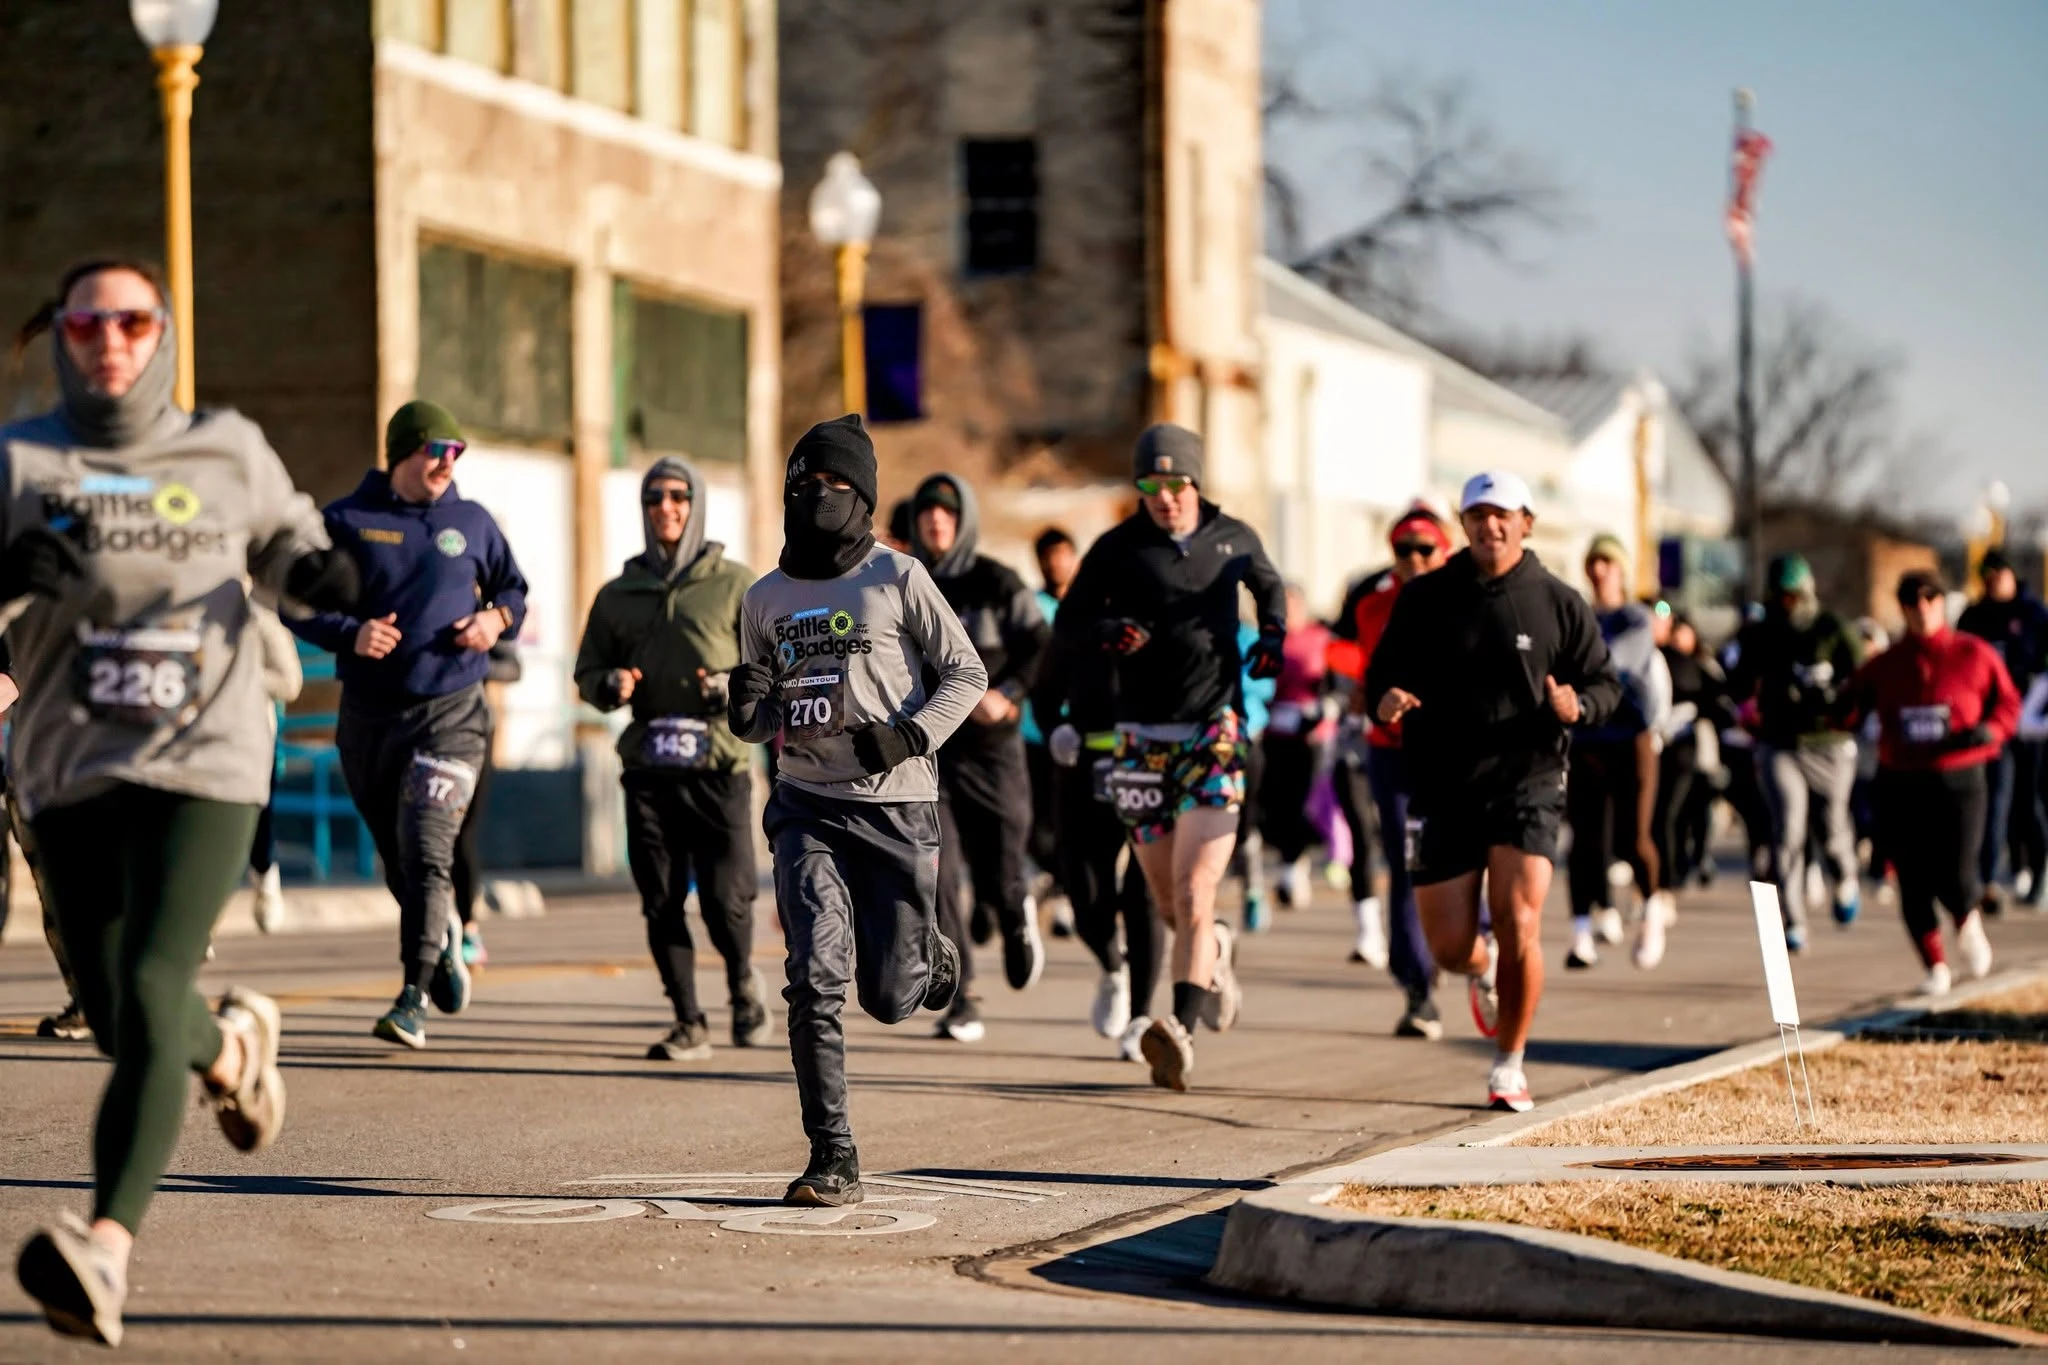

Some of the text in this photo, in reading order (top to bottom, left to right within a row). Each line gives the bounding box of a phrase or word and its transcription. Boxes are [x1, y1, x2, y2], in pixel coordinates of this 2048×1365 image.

[775, 617, 830, 644] Battle
[792, 636, 872, 660] Badges
[89, 658, 185, 708] 226
[791, 697, 831, 726] 270
[654, 732, 697, 757] 143
[428, 776, 454, 801] 17
